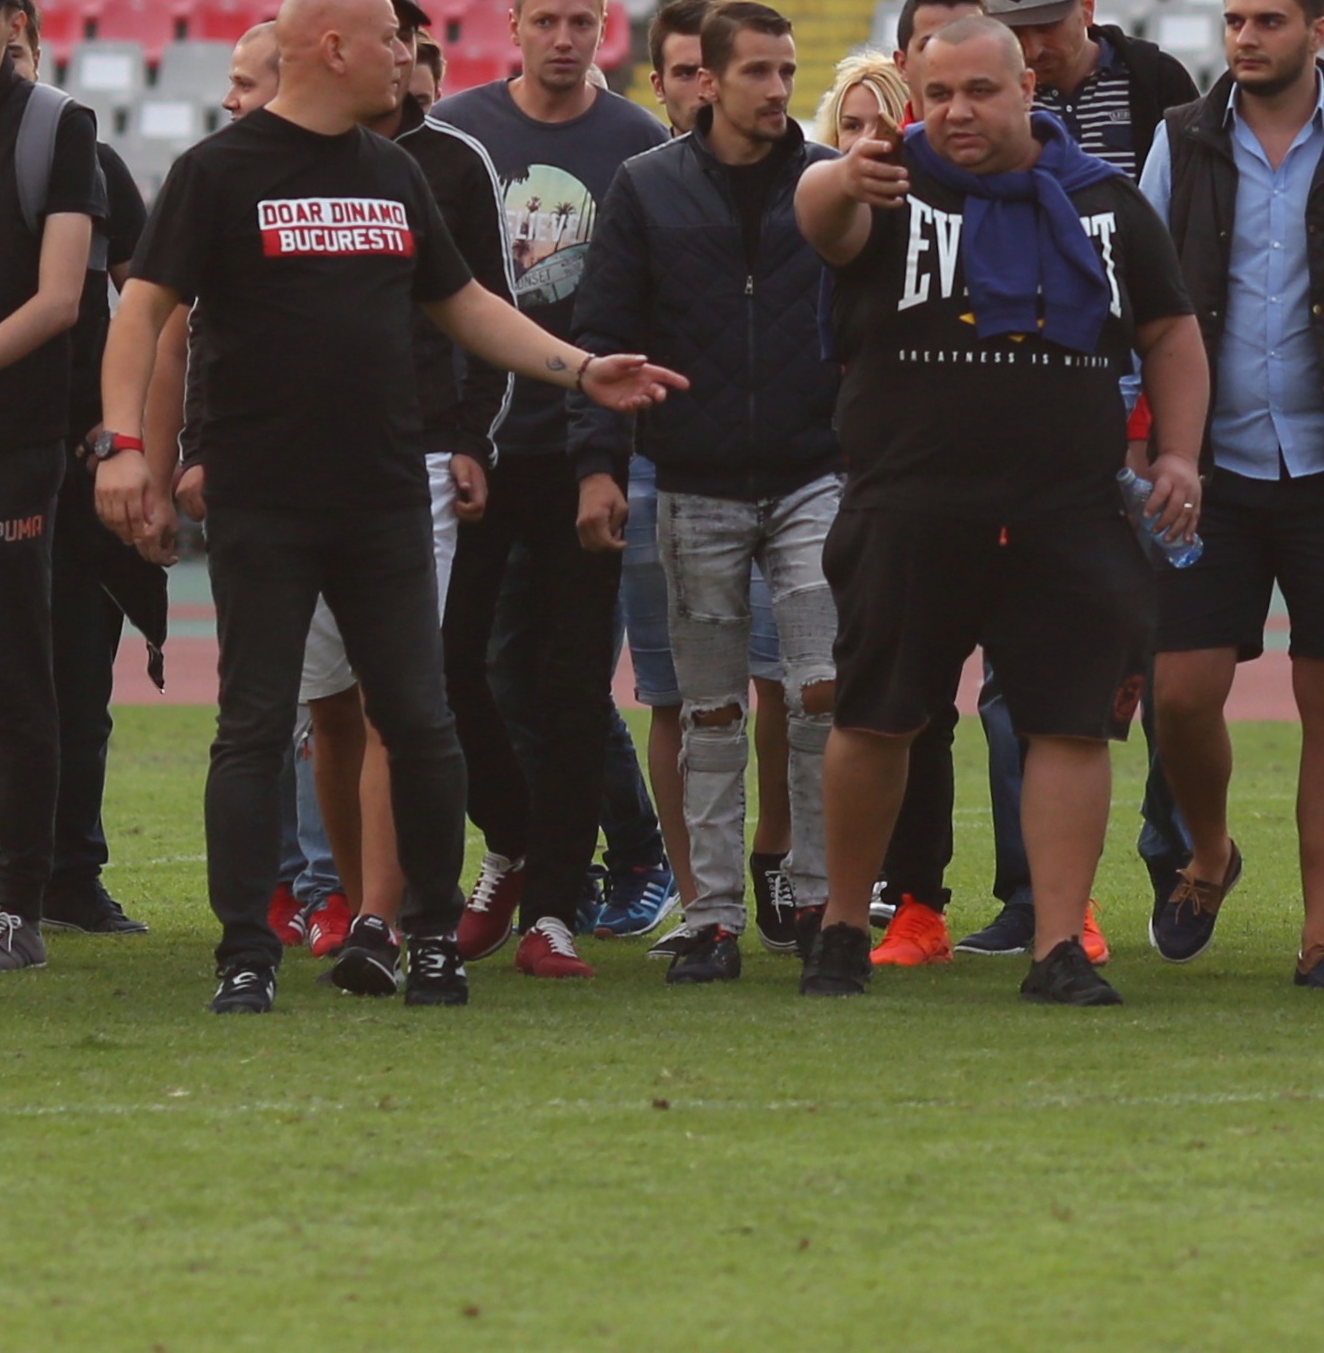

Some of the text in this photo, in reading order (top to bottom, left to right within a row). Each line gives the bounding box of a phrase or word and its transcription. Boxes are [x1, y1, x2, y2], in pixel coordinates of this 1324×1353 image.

[262, 202, 405, 225] DOAR DINAMO
[505, 210, 581, 243] ELIEVE
[279, 229, 404, 252] BUCURESTI
[898, 349, 1015, 363] GREATNESS
[1032, 353, 1049, 365] IS
